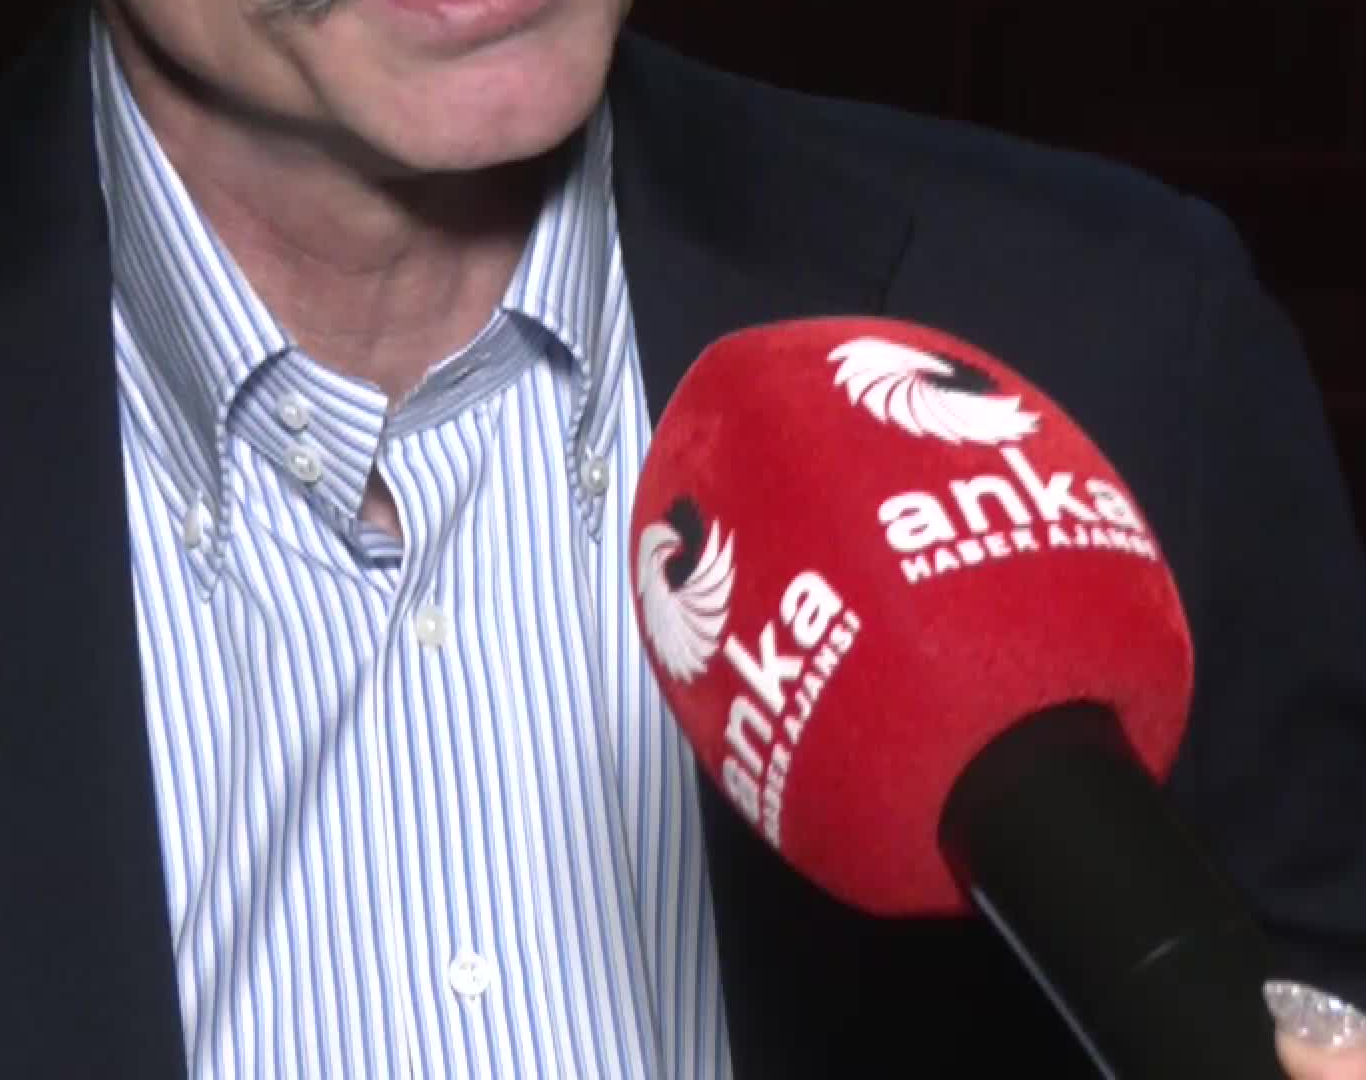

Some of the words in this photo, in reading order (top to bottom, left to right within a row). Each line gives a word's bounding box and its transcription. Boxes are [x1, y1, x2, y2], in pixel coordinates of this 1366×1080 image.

[877, 446, 1145, 553] anka
[901, 528, 1040, 585] HABER
[722, 570, 844, 824] anka
[783, 608, 862, 746] AJANSI
